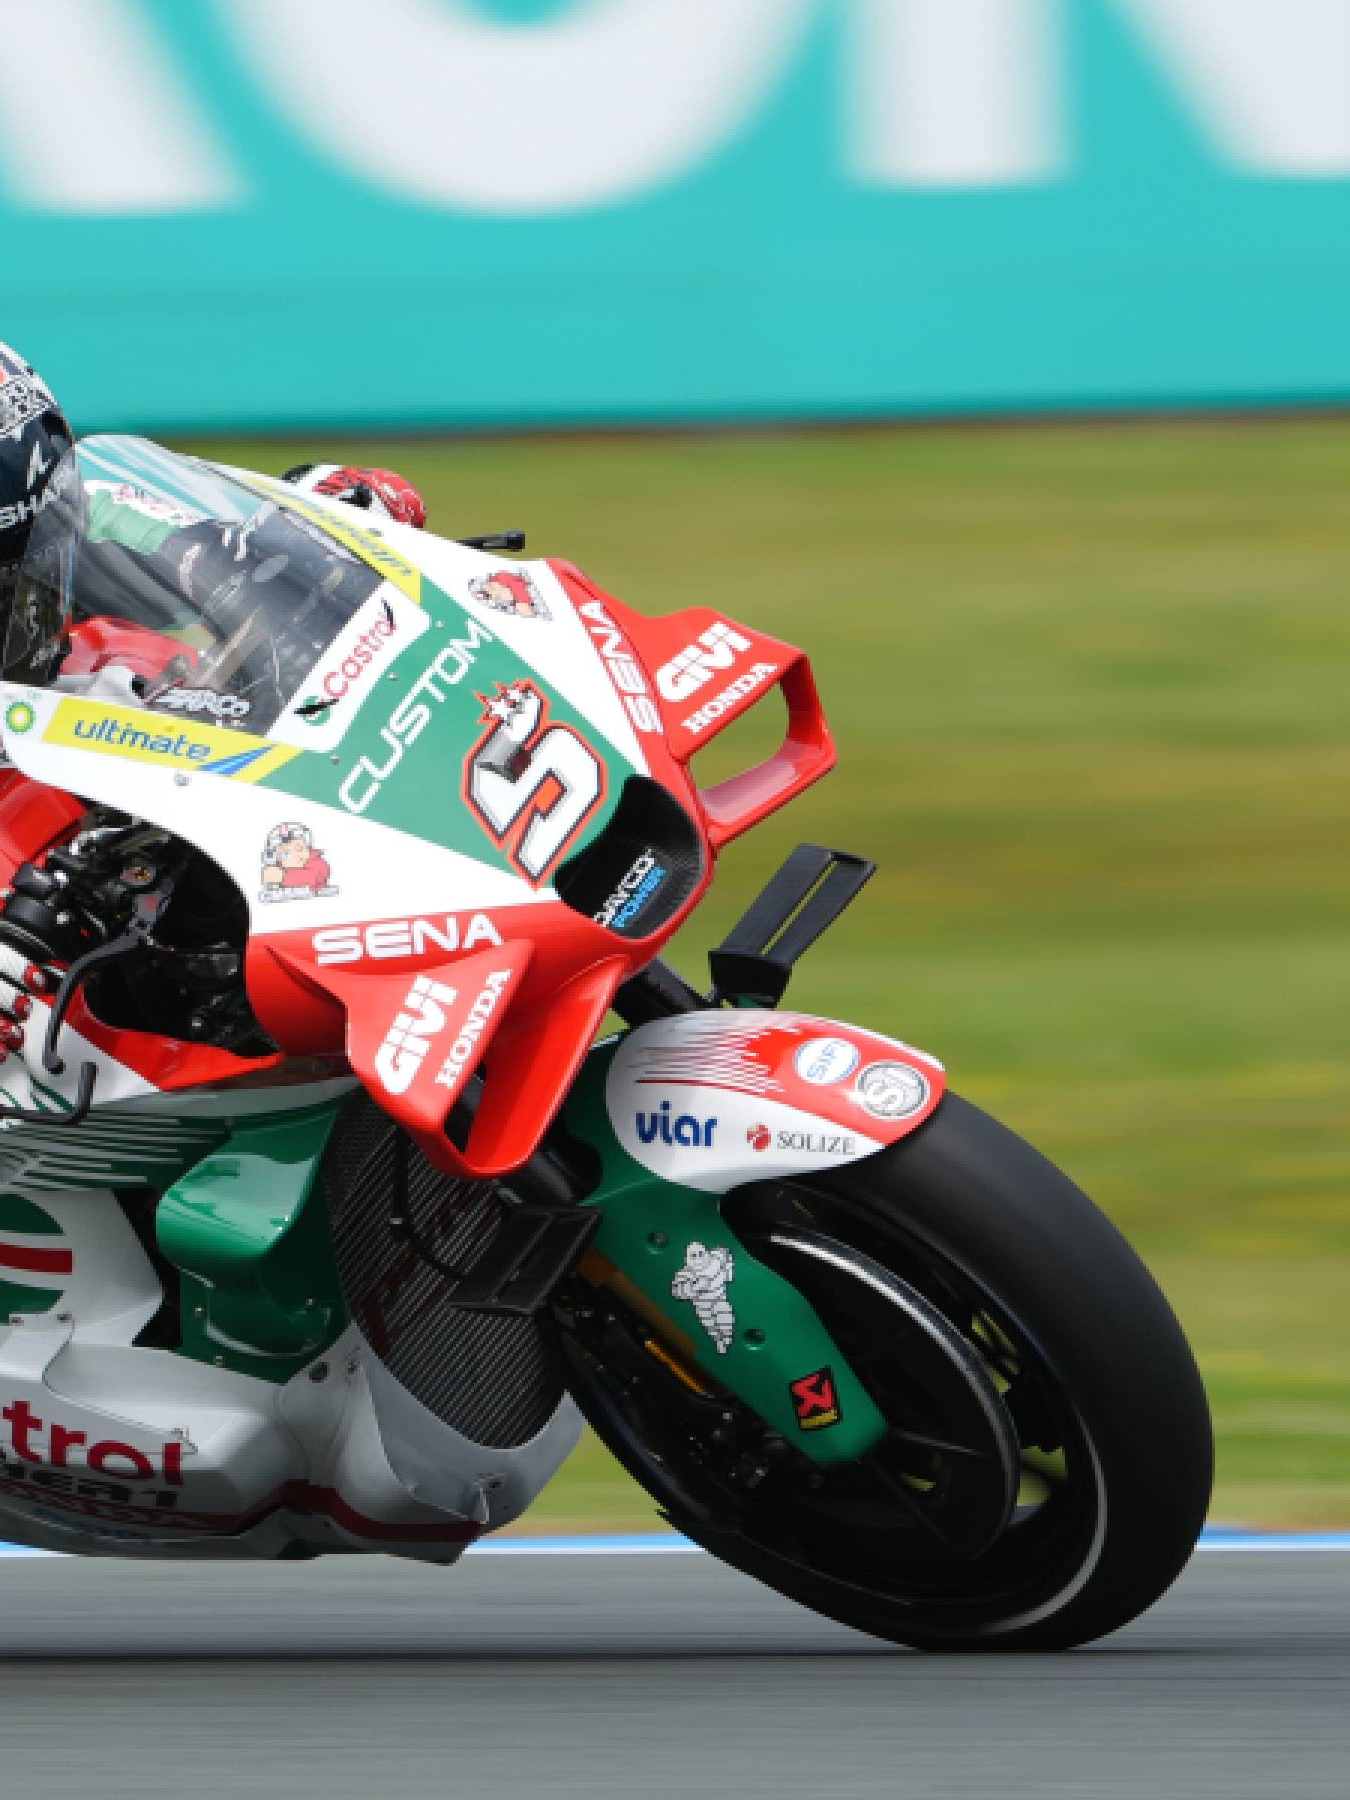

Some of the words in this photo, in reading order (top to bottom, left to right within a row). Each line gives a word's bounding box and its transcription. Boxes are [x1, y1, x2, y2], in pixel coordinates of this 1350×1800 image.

[323, 606, 397, 698] Castro
[654, 620, 754, 702] GIVI
[73, 717, 211, 761] ultimate
[339, 618, 496, 815] CUSTOM
[681, 662, 780, 736] HONDA
[462, 680, 608, 889] 5
[311, 915, 504, 967] SENA
[374, 974, 460, 1096] GIVI
[435, 968, 512, 1089] HONDA
[635, 1101, 719, 1148] viar
[776, 1129, 856, 1156] SOLIZE
